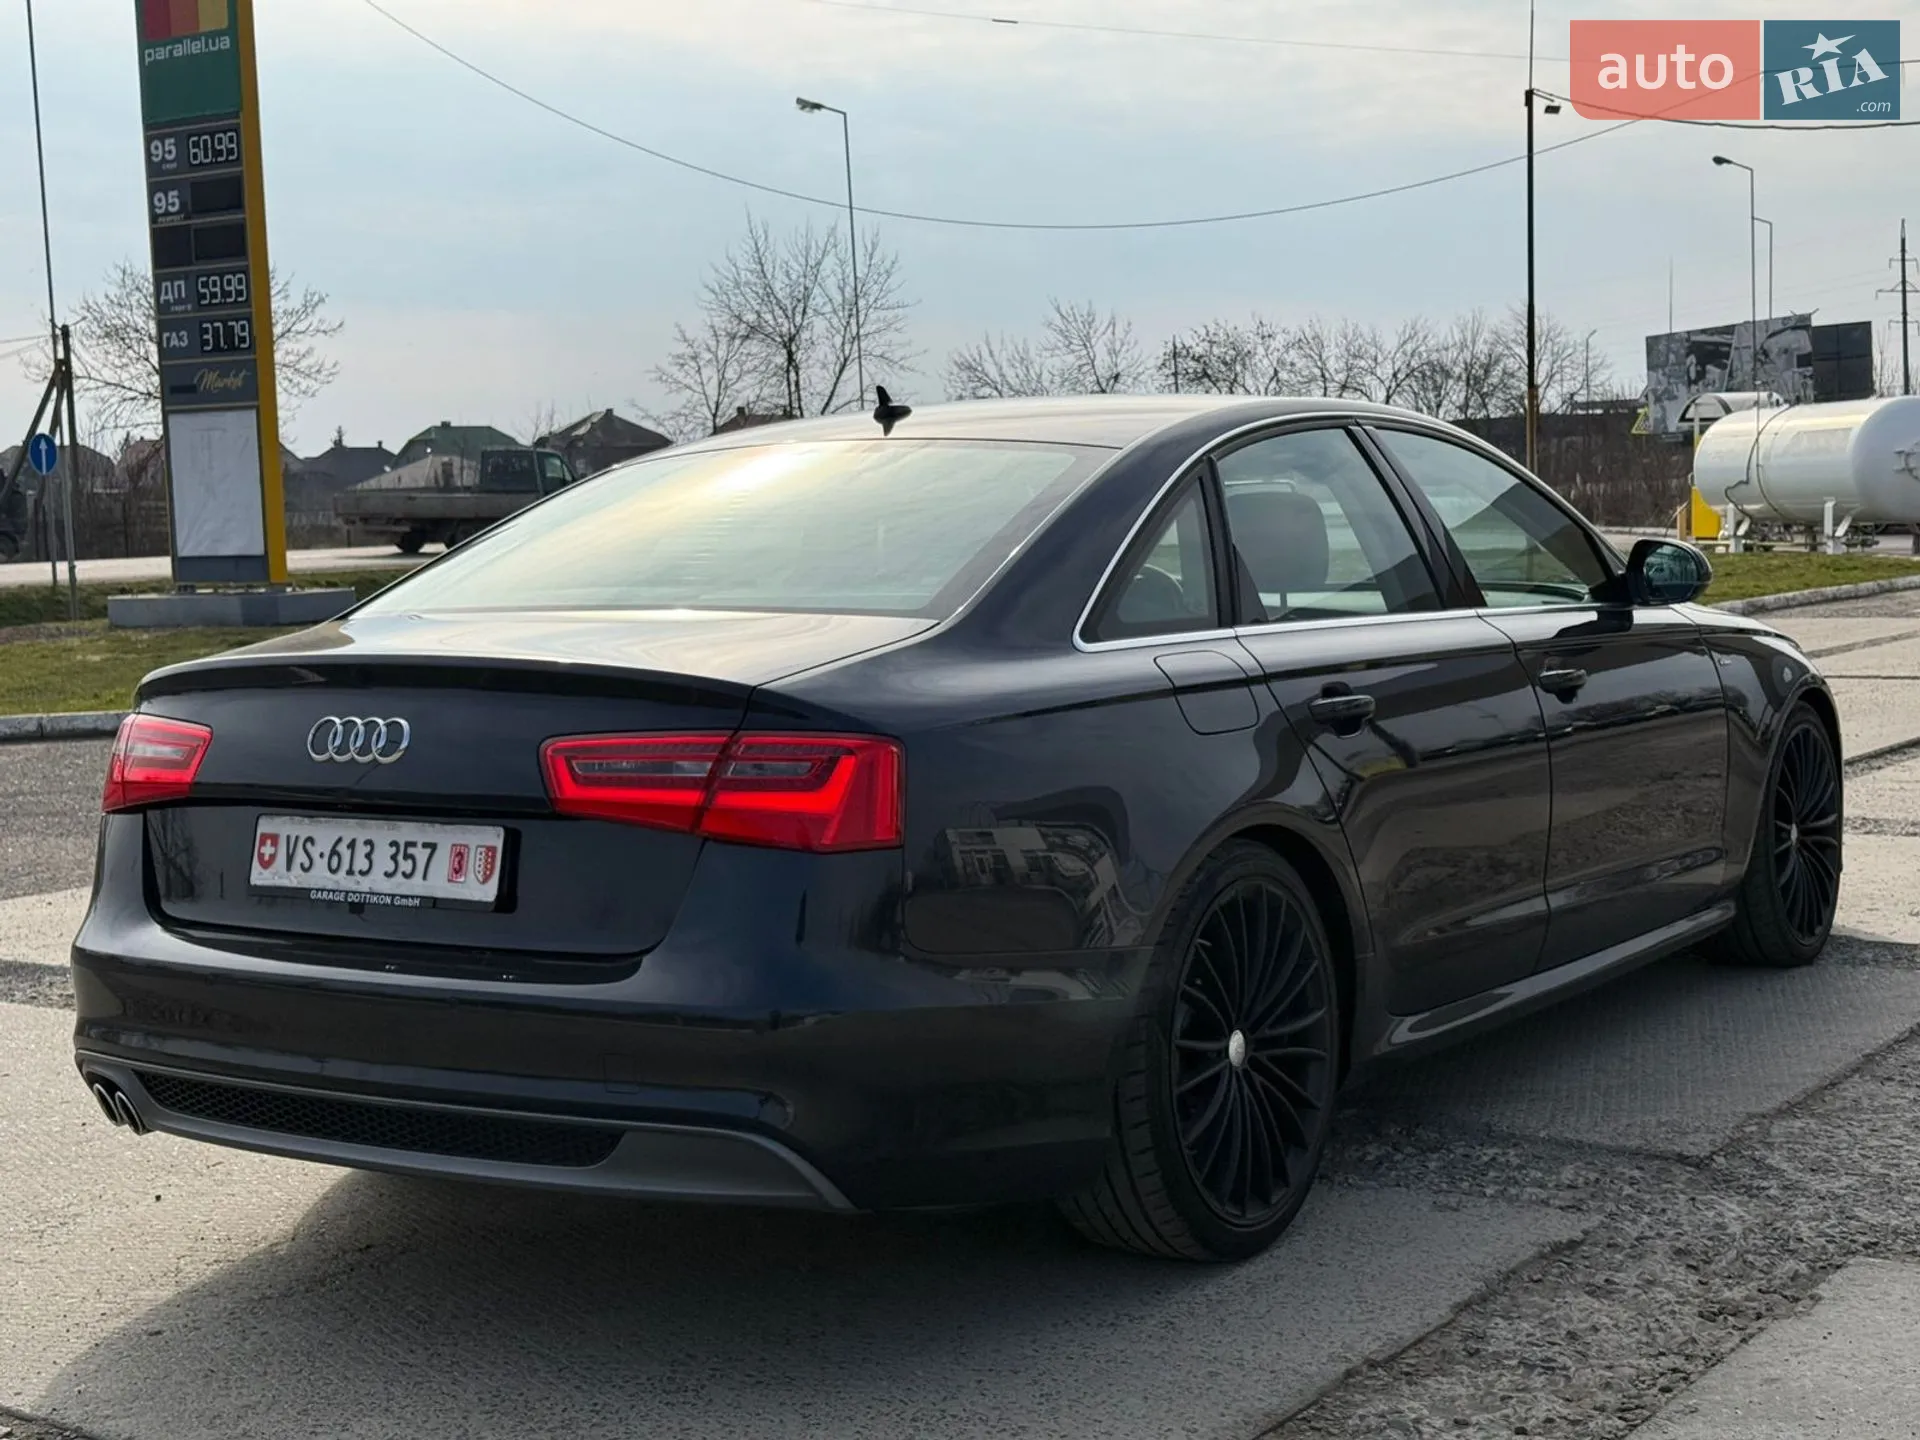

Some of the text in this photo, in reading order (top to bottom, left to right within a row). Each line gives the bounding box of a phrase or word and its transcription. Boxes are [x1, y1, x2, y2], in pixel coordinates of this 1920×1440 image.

[144, 35, 231, 66] parallel.ua
[150, 131, 238, 165] 95 60.99
[153, 189, 180, 214] 95
[159, 273, 247, 305] ДП 59.99
[162, 320, 249, 351] ГАЗ 37.79
[193, 368, 250, 393] Market
[383, 839, 438, 881] 357
[310, 889, 420, 907] GARAGE DOTTIKON GmbH
